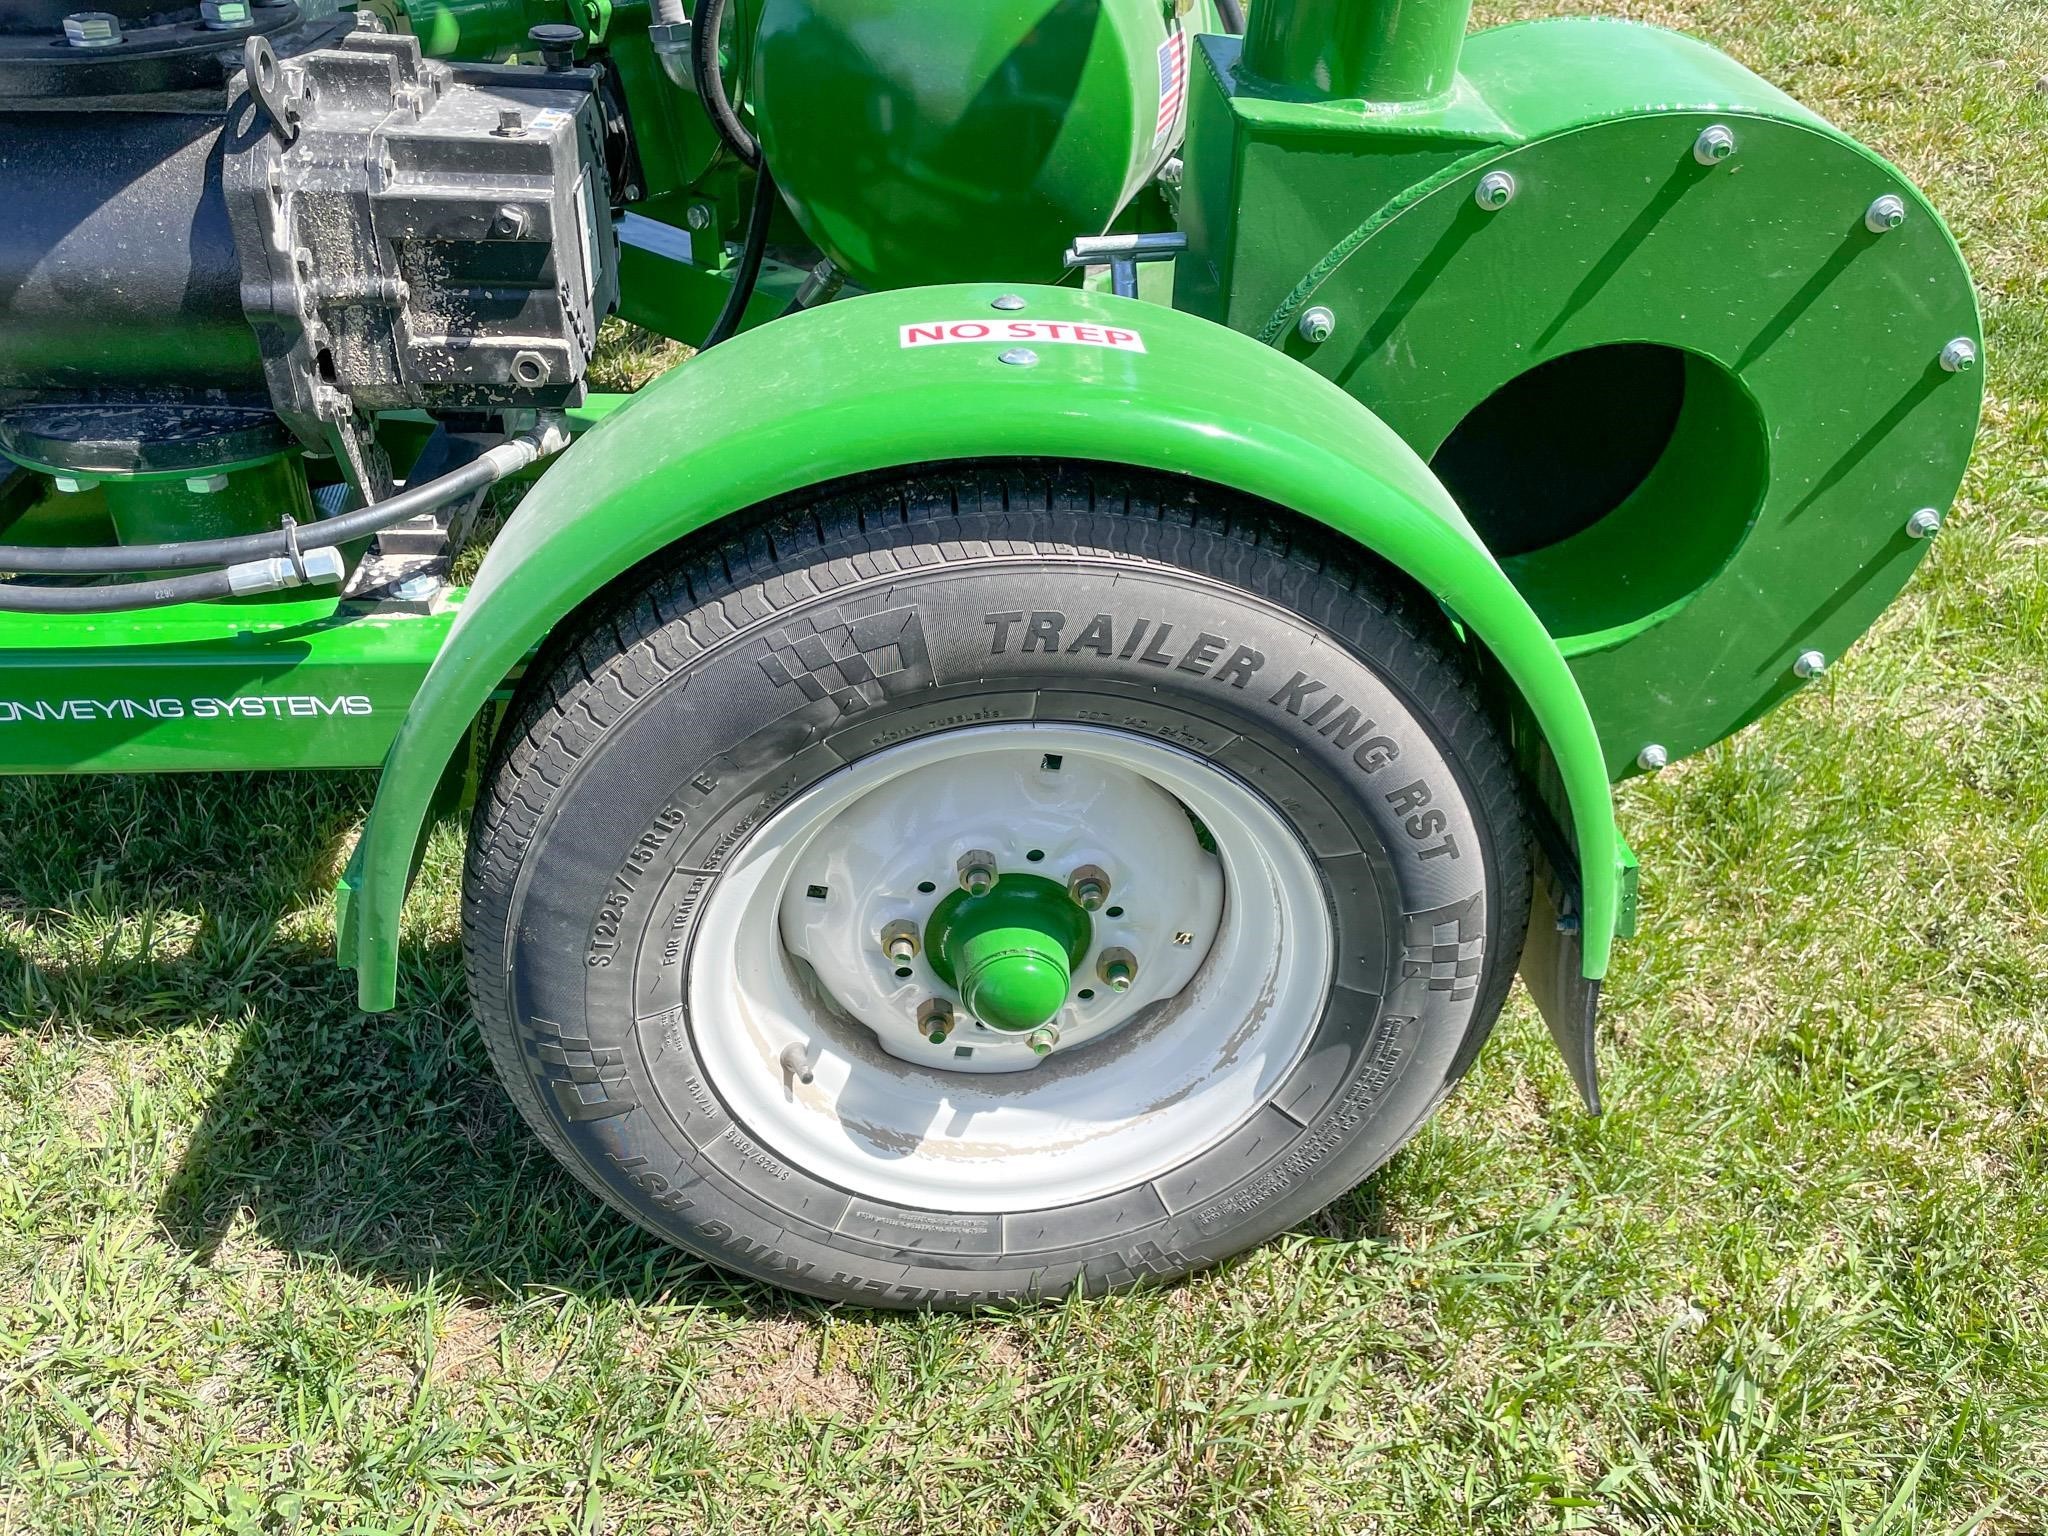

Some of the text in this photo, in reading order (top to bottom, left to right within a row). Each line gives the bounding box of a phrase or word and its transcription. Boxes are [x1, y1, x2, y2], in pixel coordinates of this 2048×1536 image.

[908, 323, 1134, 345] NO STEP
[192, 695, 373, 718] SYSTEMS
[984, 610, 1460, 861] TRAILER KING RST
[588, 771, 719, 968] ST225/75R15 E
[671, 874, 708, 931] TRAILER
[663, 934, 681, 967] FOR
[725, 1129, 789, 1181] ST225/75R15
[1291, 1133, 1341, 1177] INFLATION
[602, 1153, 697, 1213] RST
[1235, 1178, 1290, 1215] PRESSURE
[695, 1218, 816, 1280] KING
[827, 1262, 1043, 1302] RAILER
